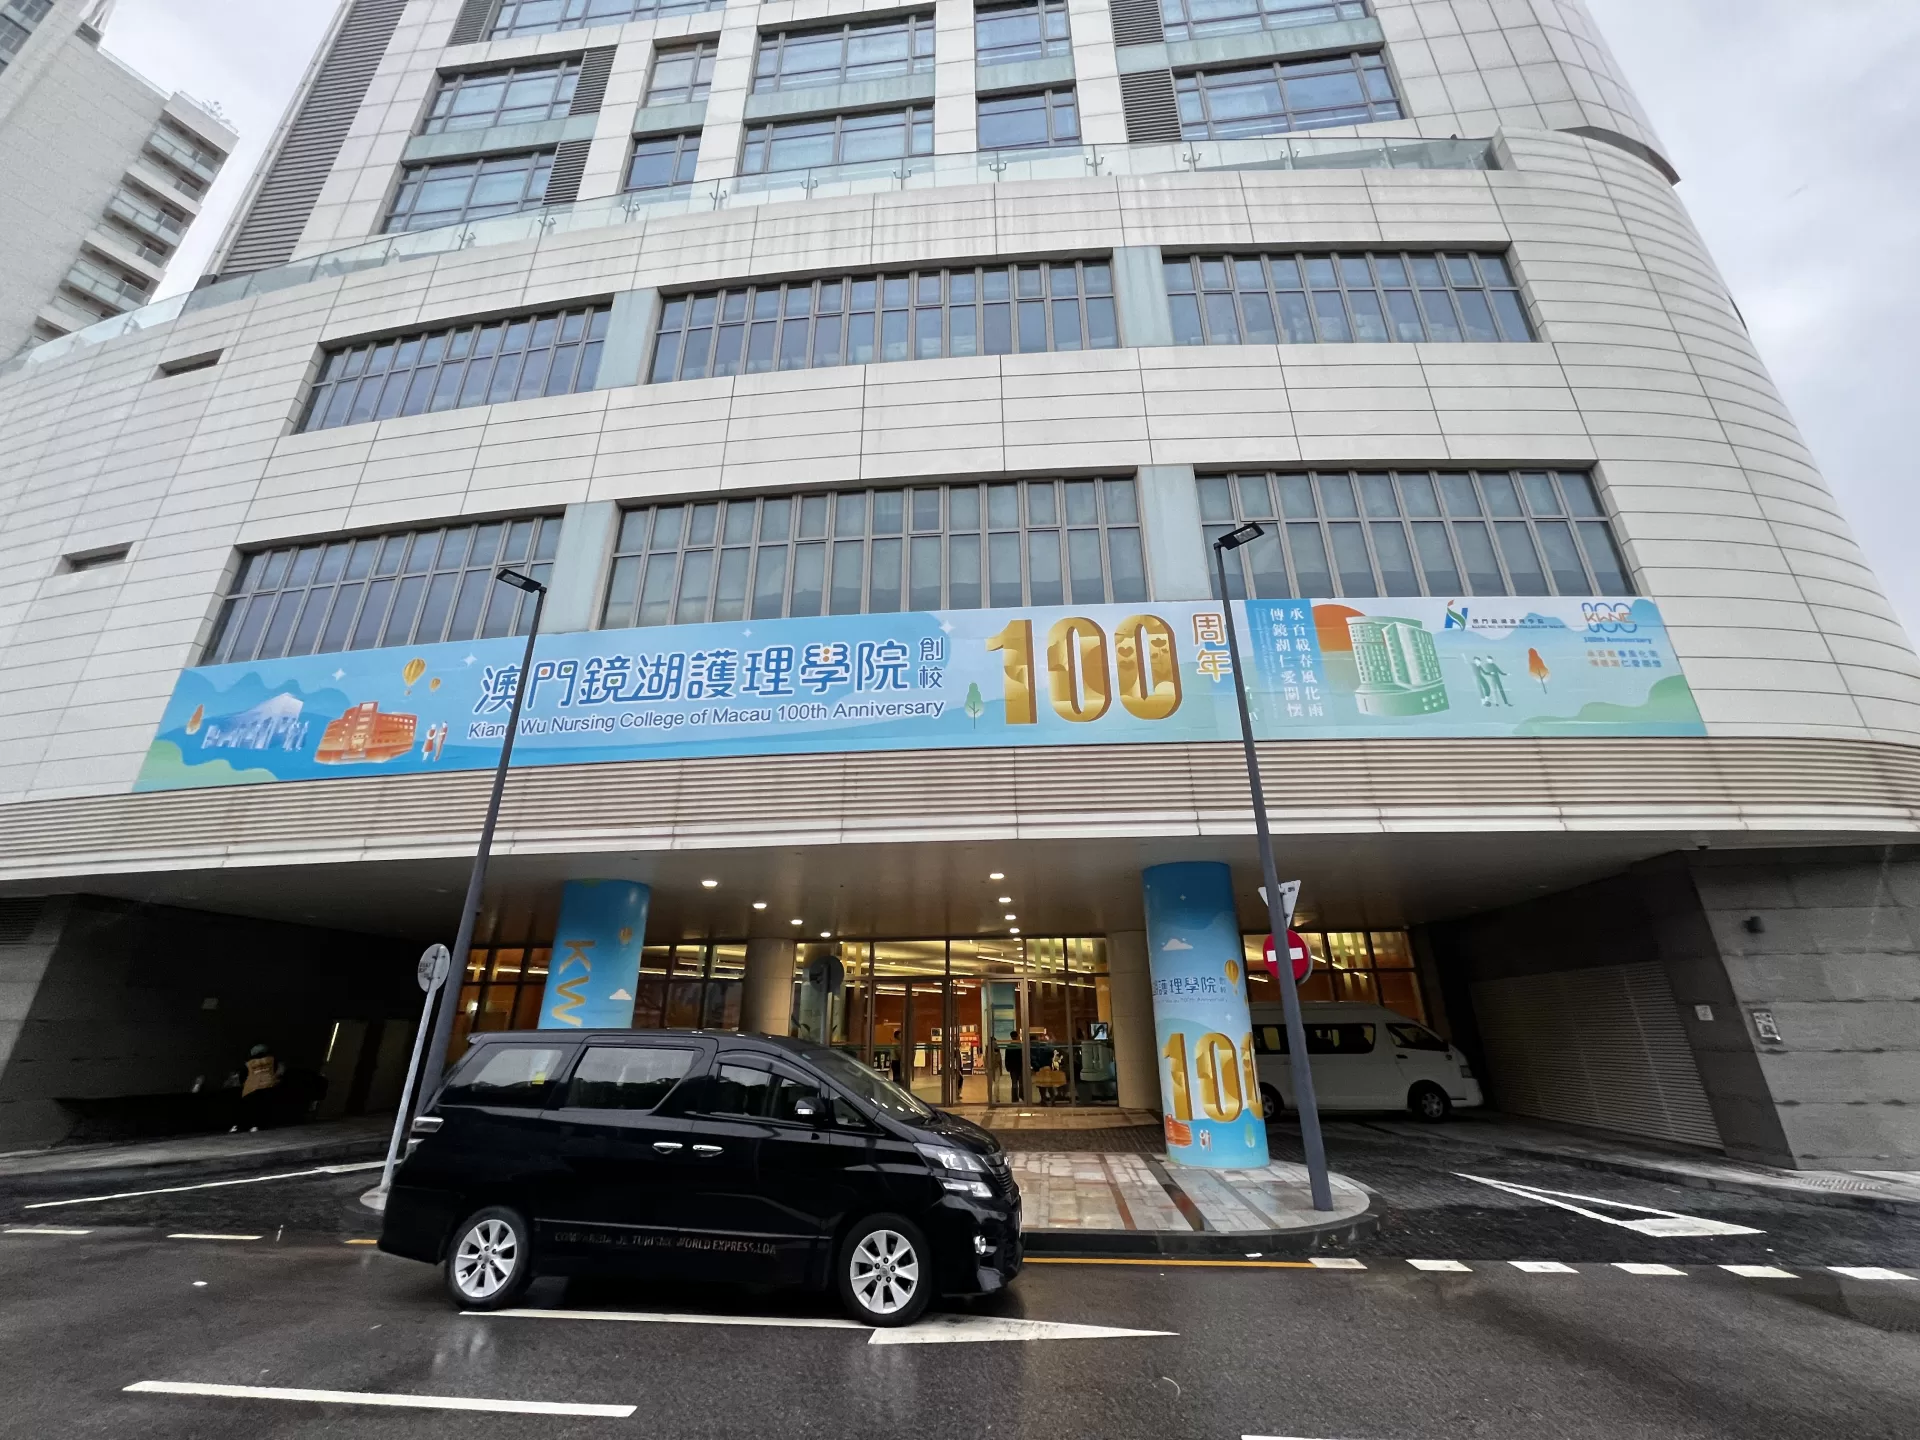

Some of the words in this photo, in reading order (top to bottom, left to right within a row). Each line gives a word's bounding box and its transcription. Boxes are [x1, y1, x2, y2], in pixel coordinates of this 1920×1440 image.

[472, 640, 908, 713] 澳門鏡湖護理學院
[919, 636, 945, 689] 創校
[986, 614, 1183, 724] 100
[1193, 614, 1232, 681] 周年
[468, 722, 508, 739] Kian
[521, 719, 547, 734] Wu
[551, 715, 616, 734] Nursing
[620, 710, 684, 730] College
[690, 709, 707, 725] of
[712, 706, 771, 723] Macau
[778, 702, 827, 720] 100th
[833, 700, 945, 719] Anniversary
[676, 1237, 710, 1250] WORLD
